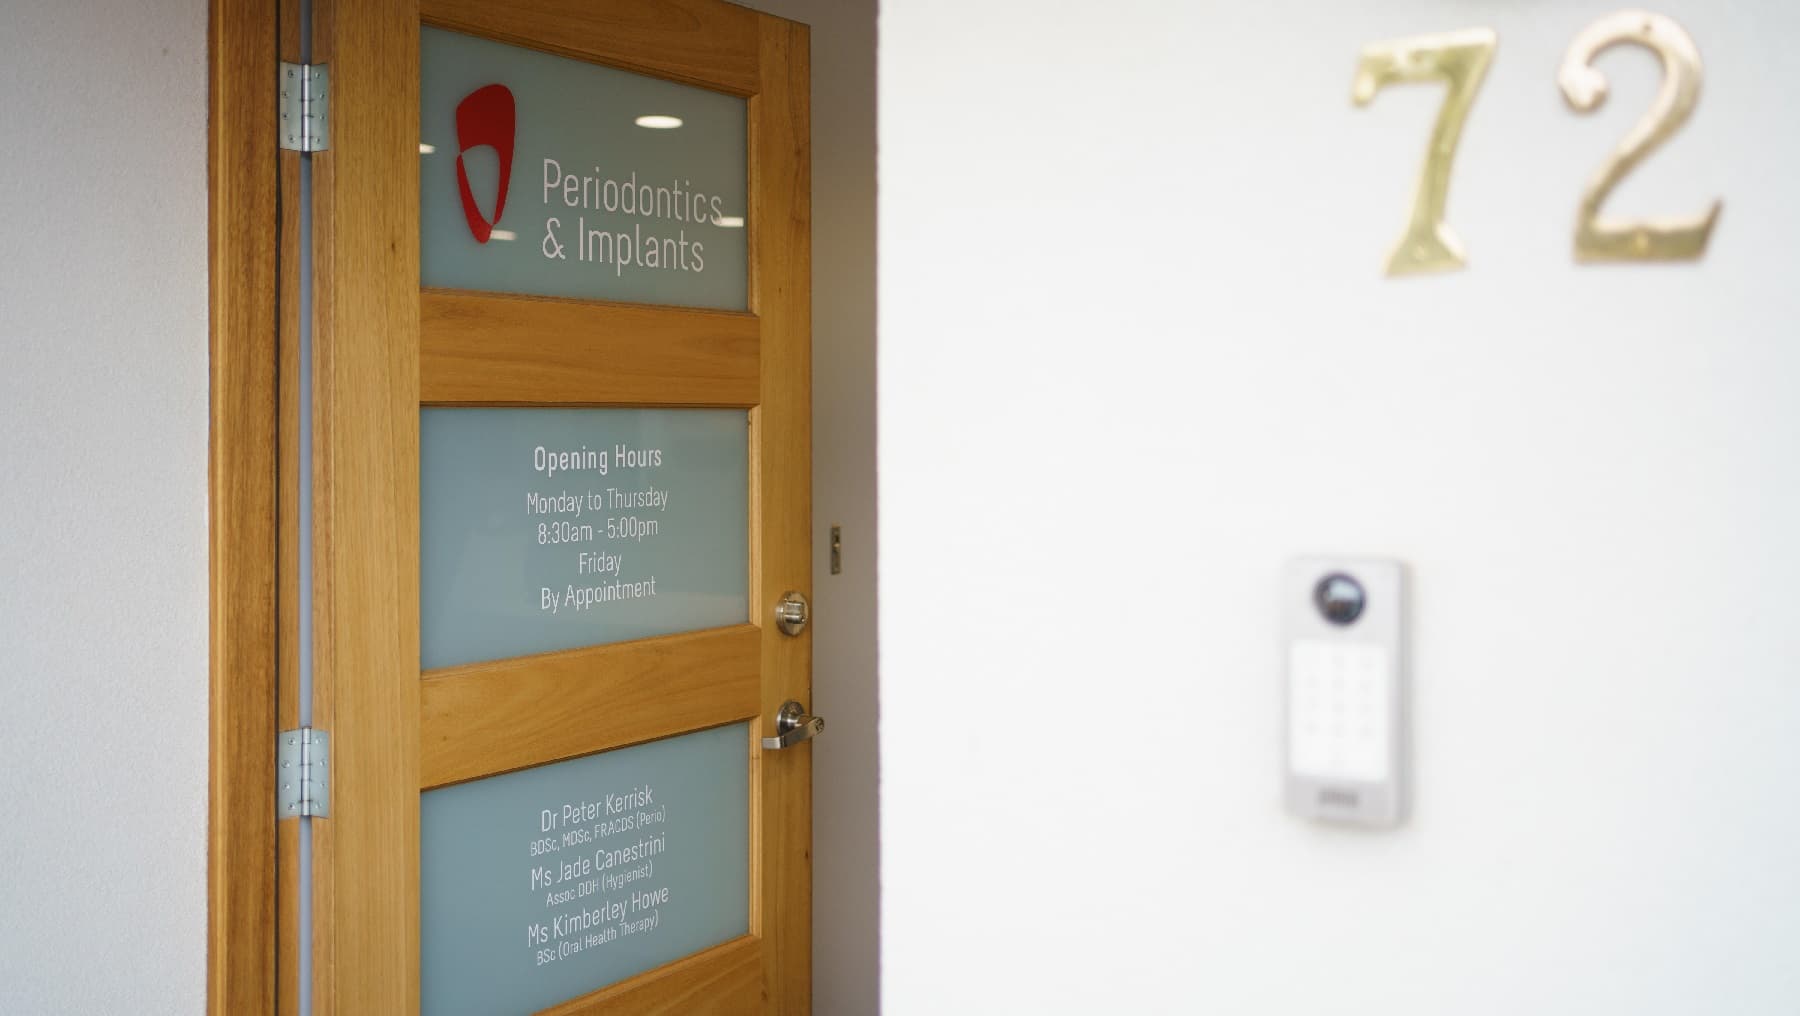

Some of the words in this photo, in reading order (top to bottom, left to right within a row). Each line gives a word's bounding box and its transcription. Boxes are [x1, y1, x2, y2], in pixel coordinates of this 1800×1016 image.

[1352, 9, 1723, 279] 72
[544, 158, 722, 224] Periodontics
[543, 217, 566, 259] &
[579, 217, 704, 277] Implants
[534, 445, 608, 478] Opening
[615, 444, 662, 468] Hours
[527, 489, 583, 518] Monday
[587, 490, 602, 510] to
[607, 487, 668, 511] Thursday
[538, 521, 593, 544] 8:30am
[607, 516, 658, 542] 5:00pm
[579, 552, 622, 576] Friday
[541, 587, 560, 614] By
[565, 576, 656, 611] Appointment
[530, 837, 560, 856] BDSc,
[562, 829, 592, 848] MDSc,
[594, 815, 634, 839] FRACDS
[636, 804, 666, 830] (Perio)
[541, 809, 558, 832] Dr
[563, 801, 601, 827] Peter
[606, 784, 653, 816] Kerrisk
[531, 866, 552, 891] Ms
[556, 856, 590, 883] Jade
[595, 832, 665, 871] Canestrini
[546, 888, 575, 907] Assoc
[602, 860, 653, 892] (Hygienist)
[528, 924, 548, 948] Ms
[554, 900, 628, 939] Kimberley
[632, 887, 669, 913] Howe
[537, 948, 556, 966] BSc
[558, 937, 582, 960] (Oral
[585, 926, 617, 949] Health
[619, 909, 659, 937] Therapy)
